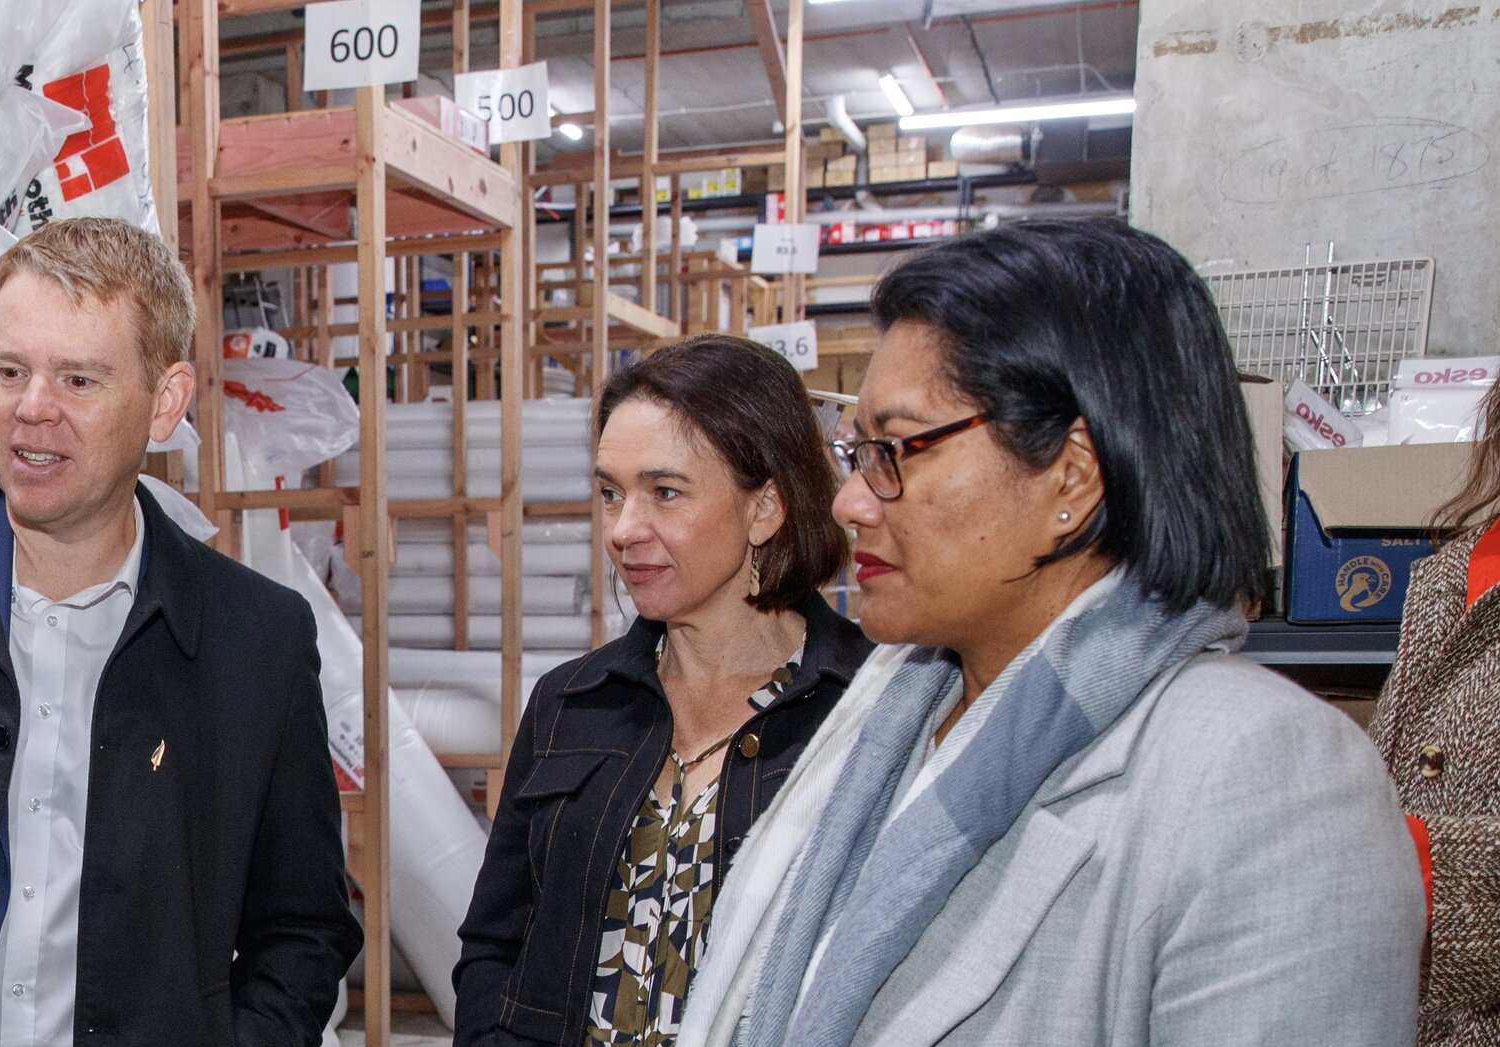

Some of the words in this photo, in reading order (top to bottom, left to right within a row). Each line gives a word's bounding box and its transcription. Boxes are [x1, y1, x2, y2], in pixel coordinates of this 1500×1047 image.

[329, 24, 398, 62] 600
[478, 90, 533, 121] 500
[1337, 557, 1368, 586] HANDLE
[1374, 573, 1389, 598] CARE
